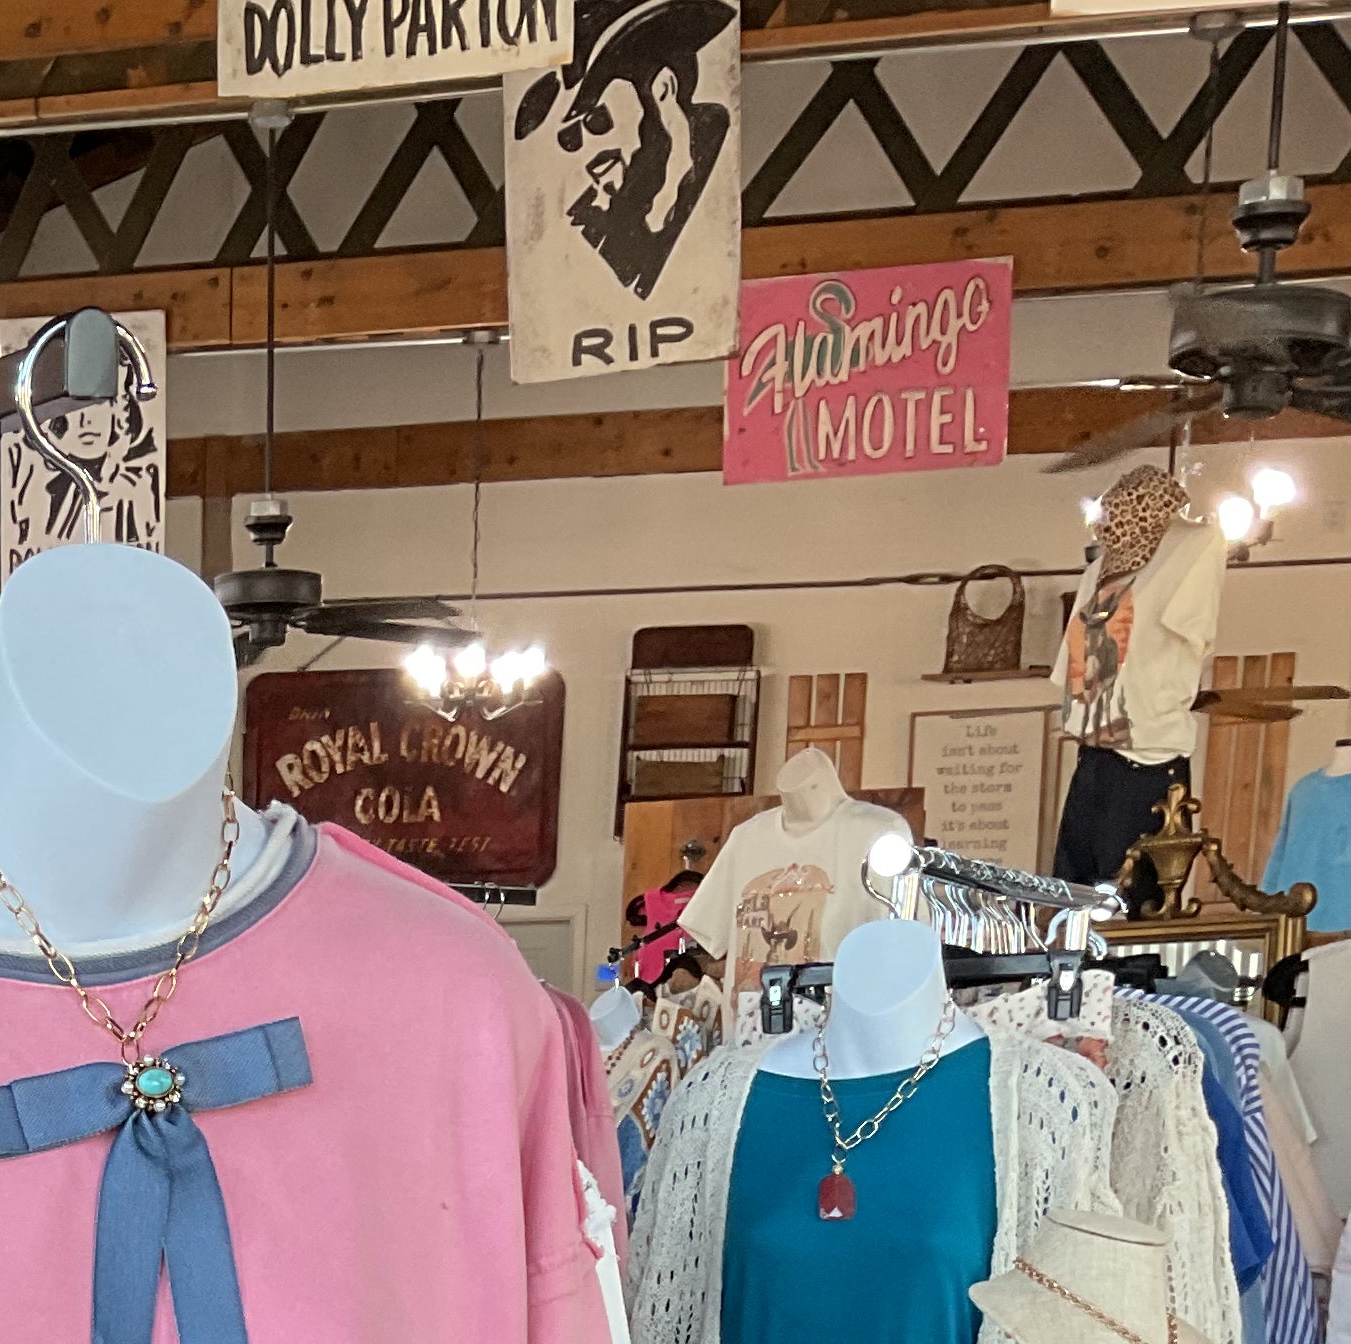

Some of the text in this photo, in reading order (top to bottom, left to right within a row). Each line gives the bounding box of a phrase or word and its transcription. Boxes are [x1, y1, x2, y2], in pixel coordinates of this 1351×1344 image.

[243, 0, 369, 77] DOLLY
[571, 316, 694, 368] RIP
[740, 276, 990, 415] Flamingo
[816, 386, 989, 462] MOTEL
[966, 724, 997, 738] Life
[275, 721, 527, 798] ROYAL CROWN
[979, 744, 1020, 756] about
[936, 761, 1023, 777] waiting for
[944, 782, 1012, 794] the storm
[354, 785, 441, 825] COLA
[951, 801, 966, 813] to
[969, 819, 1010, 831] about
